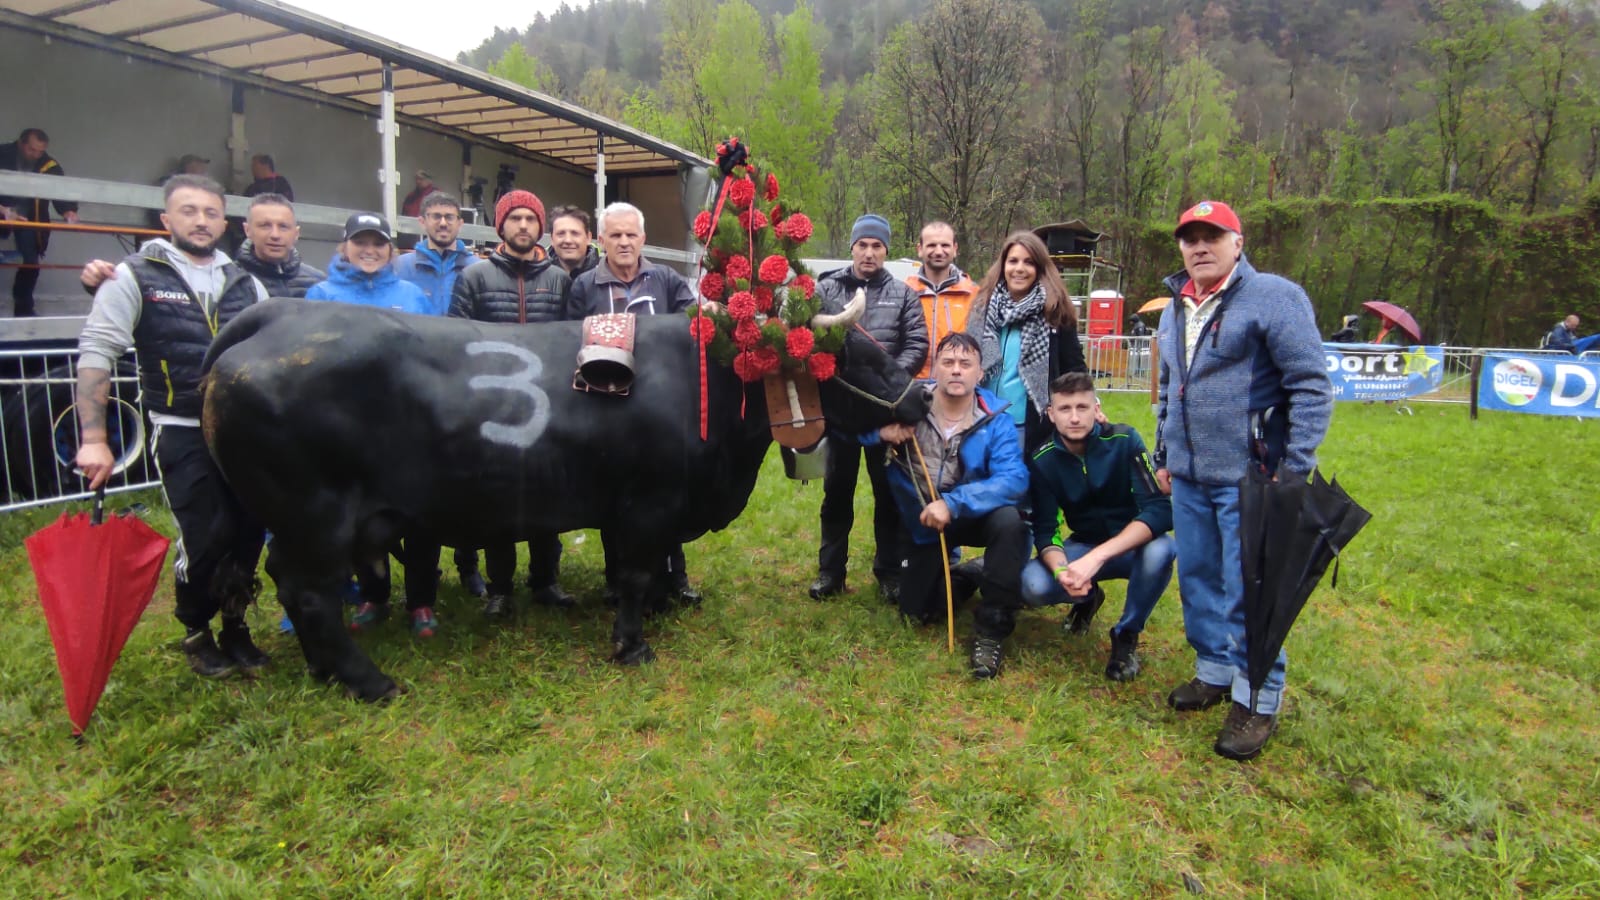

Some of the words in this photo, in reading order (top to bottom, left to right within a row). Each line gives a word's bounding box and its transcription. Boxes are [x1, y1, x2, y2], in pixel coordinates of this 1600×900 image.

[465, 340, 549, 448] 3
[1496, 373, 1538, 387] DIGEL
[1550, 364, 1600, 409] D
